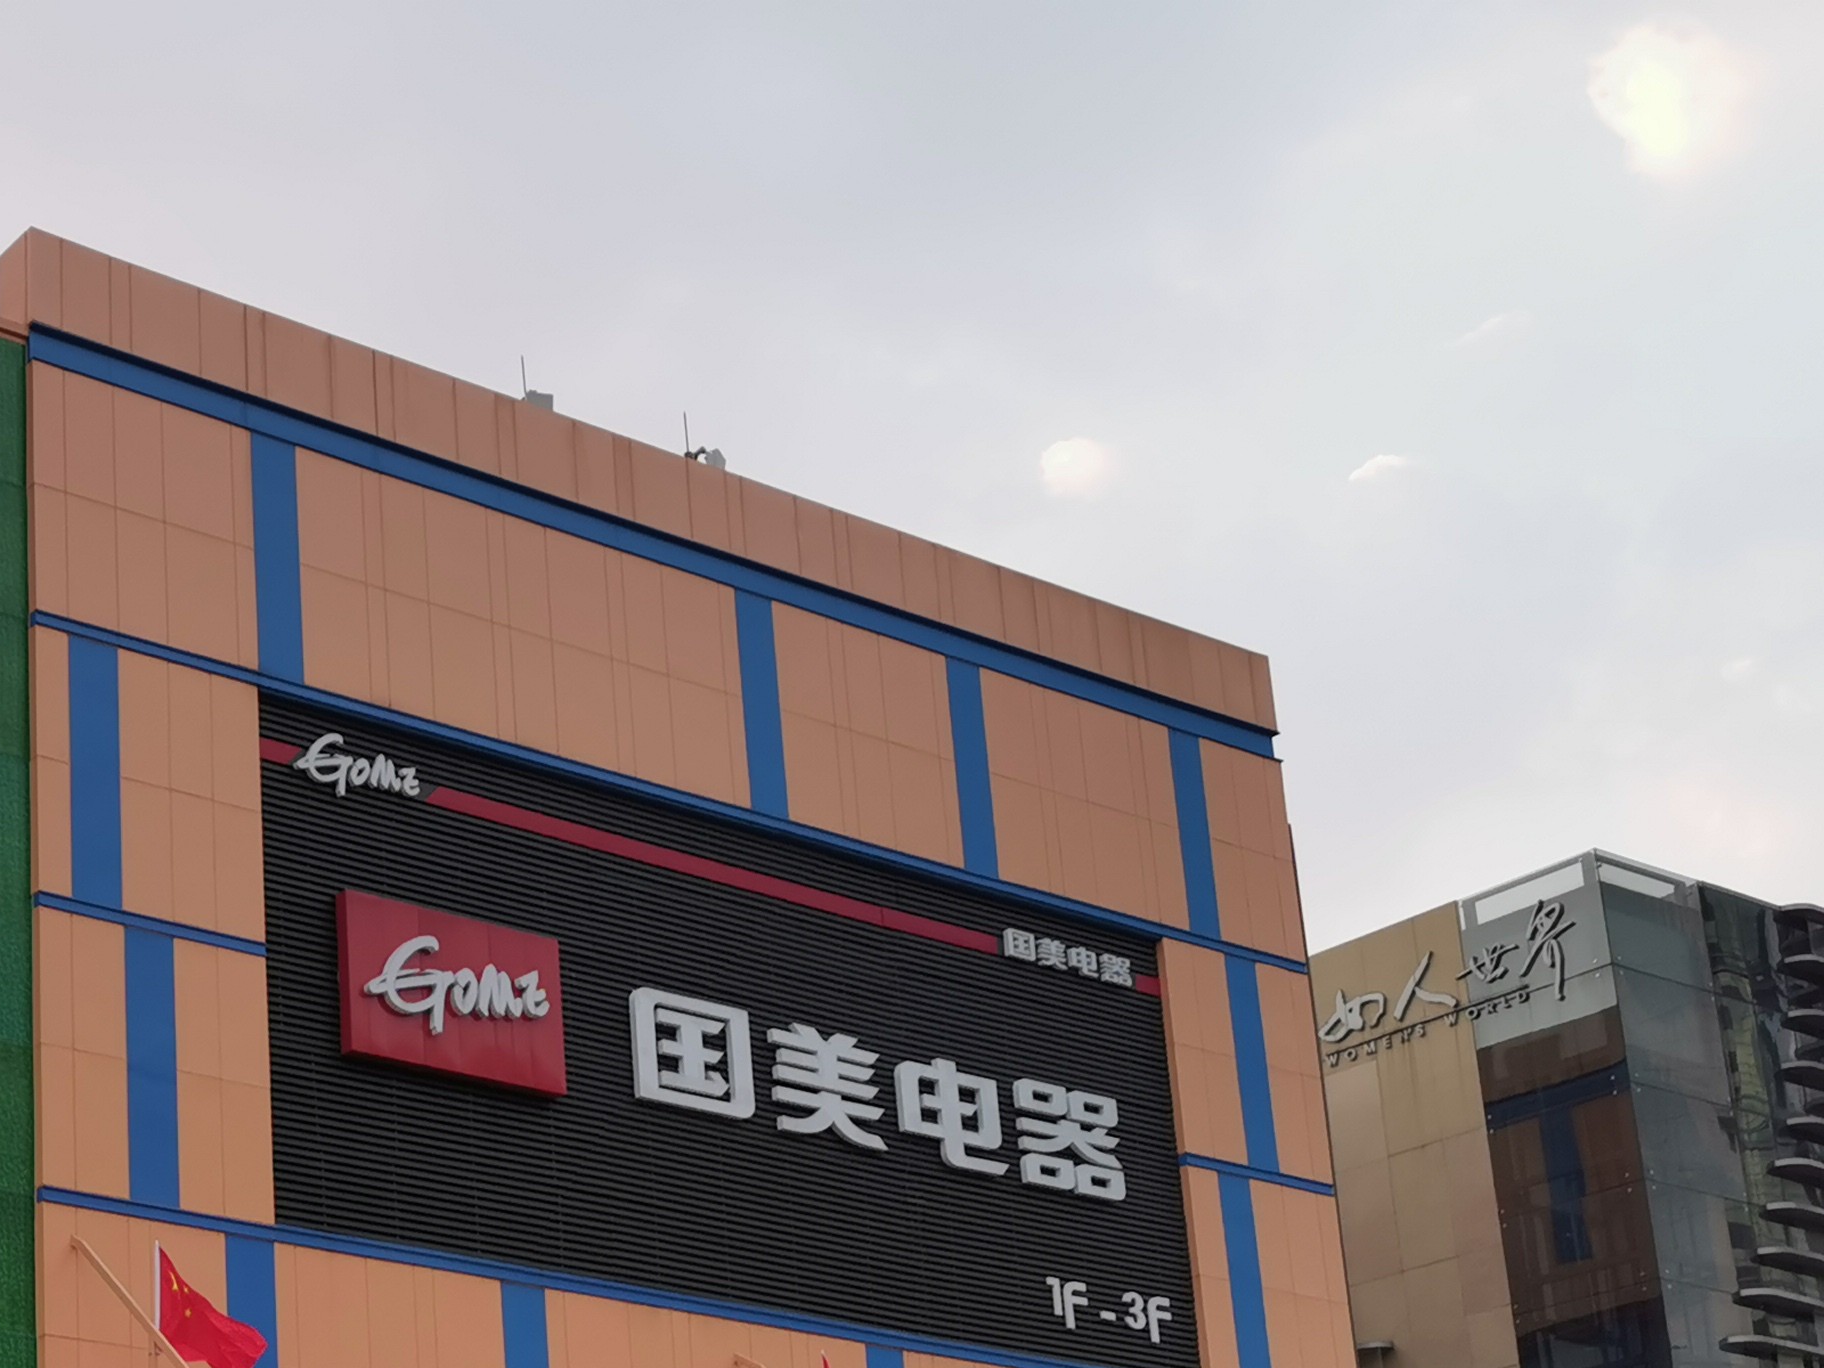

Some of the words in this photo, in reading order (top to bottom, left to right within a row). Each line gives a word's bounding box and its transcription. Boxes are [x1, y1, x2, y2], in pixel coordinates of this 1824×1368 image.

[1002, 928, 1132, 986] 国美电器
[1326, 1024, 1425, 1067] WOMEN'S
[1444, 990, 1530, 1026] WORLD
[629, 986, 1126, 1201] 国美电器
